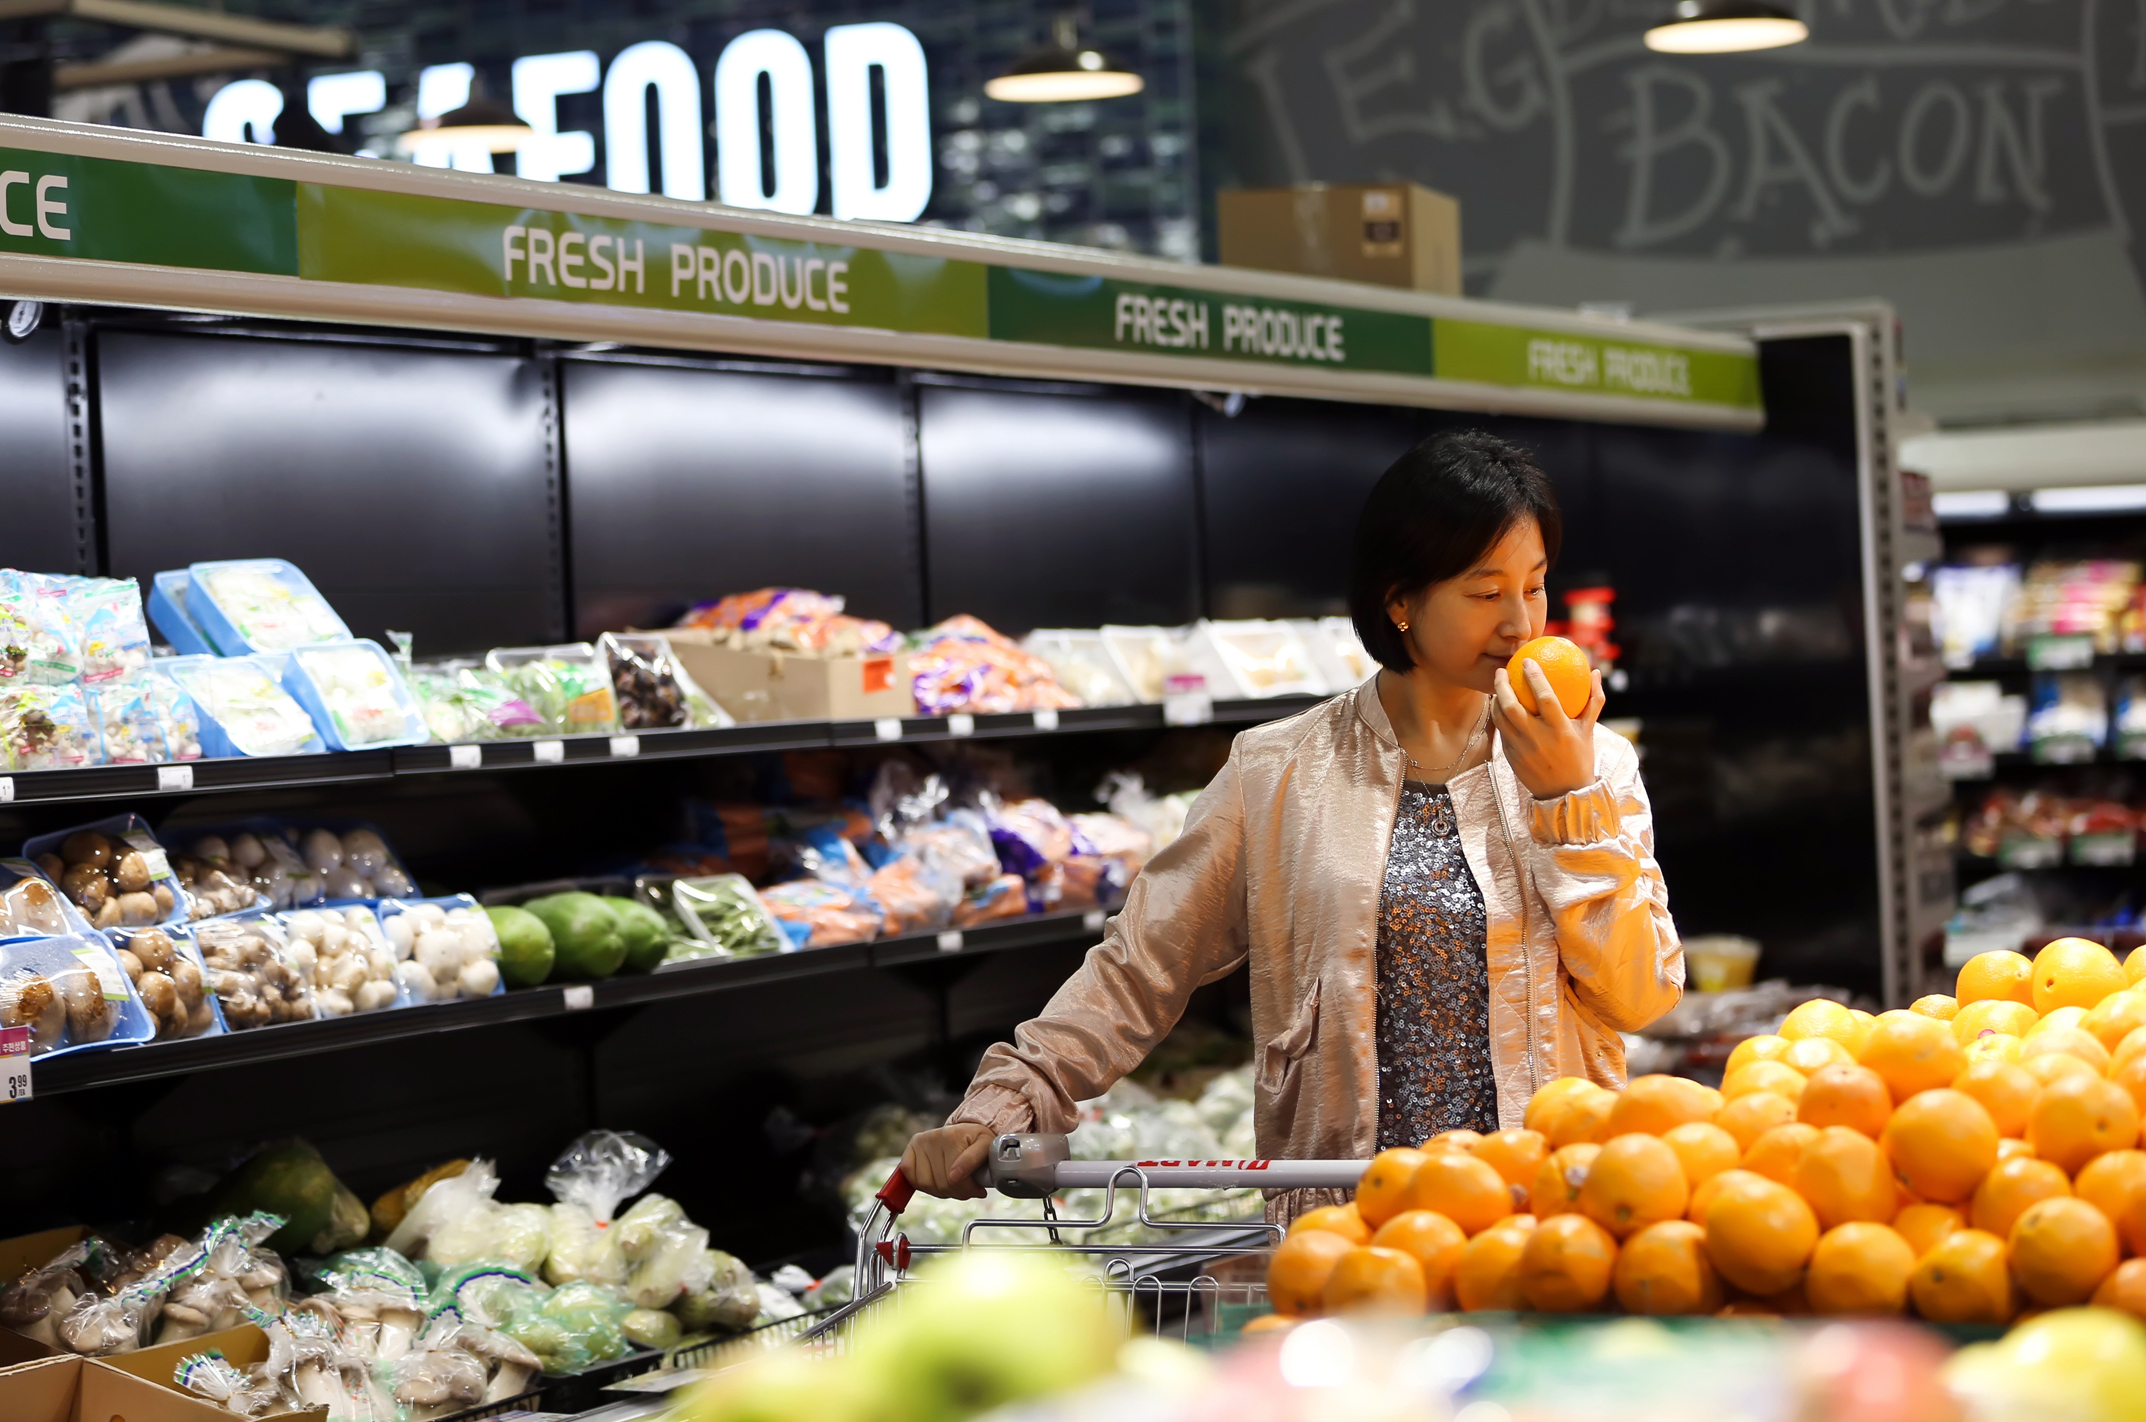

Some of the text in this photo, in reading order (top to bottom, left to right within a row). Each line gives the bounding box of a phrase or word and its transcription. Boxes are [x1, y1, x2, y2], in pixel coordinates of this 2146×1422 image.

[1608, 64, 2064, 250] BACON
[0, 170, 71, 241] CE
[503, 225, 849, 314] FRESH PRODUCE
[1115, 293, 1346, 363] FRESH PRODUCE
[1528, 339, 1692, 396] FRESH PRODUCE
